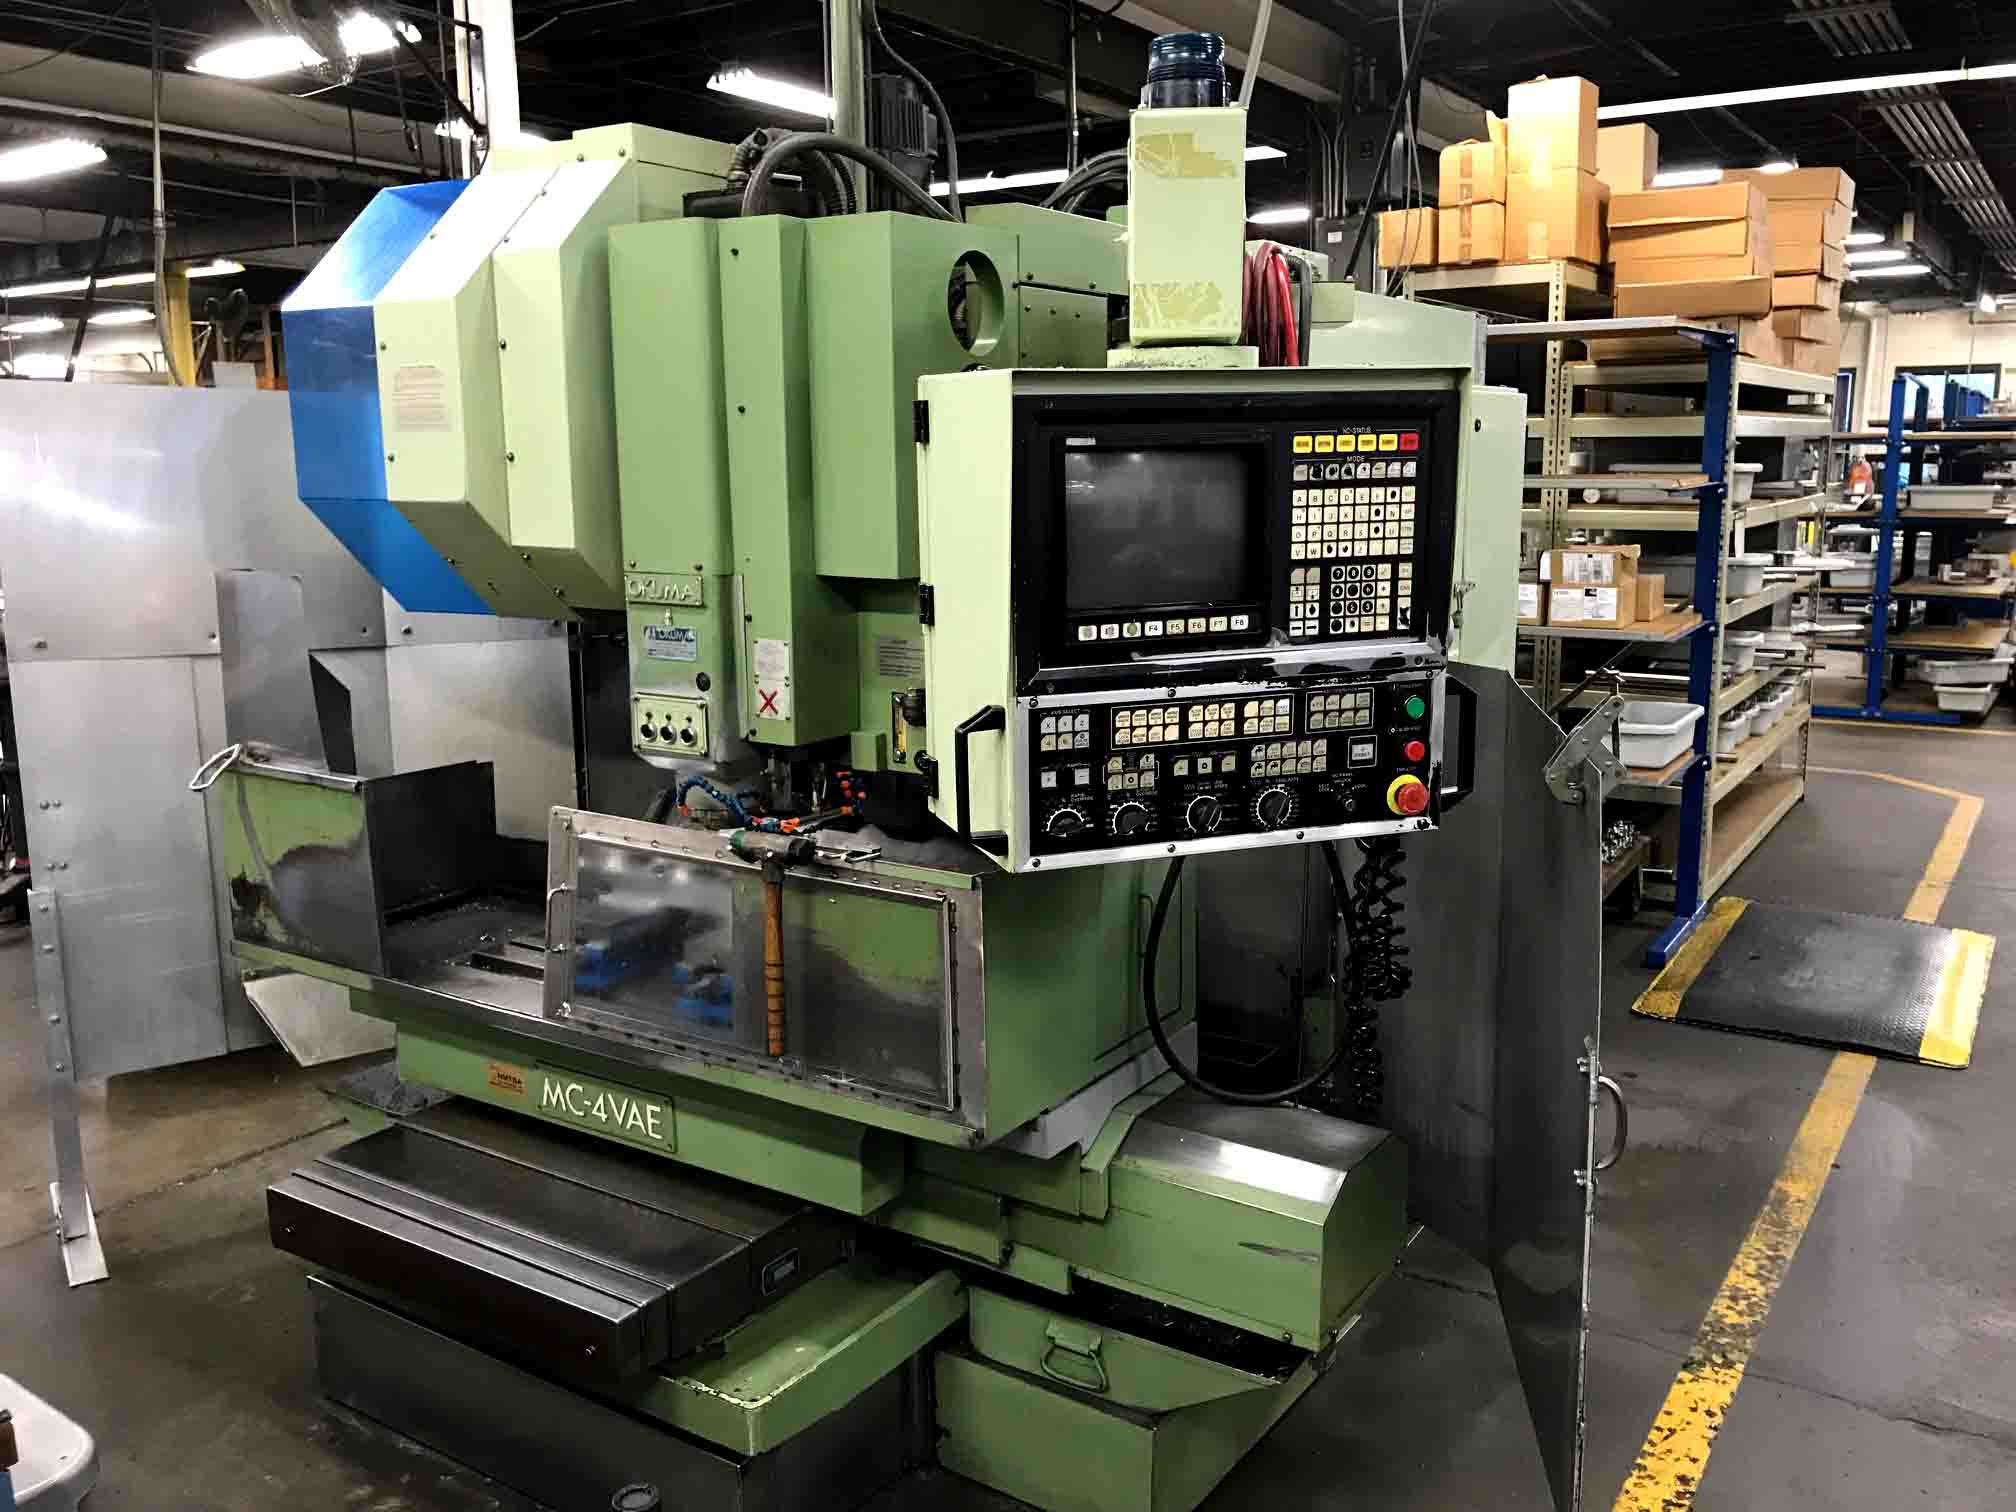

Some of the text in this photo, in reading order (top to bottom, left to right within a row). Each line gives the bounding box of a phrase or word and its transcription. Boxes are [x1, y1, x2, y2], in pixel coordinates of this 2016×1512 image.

[629, 580, 696, 601] OKUMA
[1171, 623, 1180, 631] F5
[1192, 622, 1202, 630] F6
[543, 1078, 663, 1139] MC-4VAE
